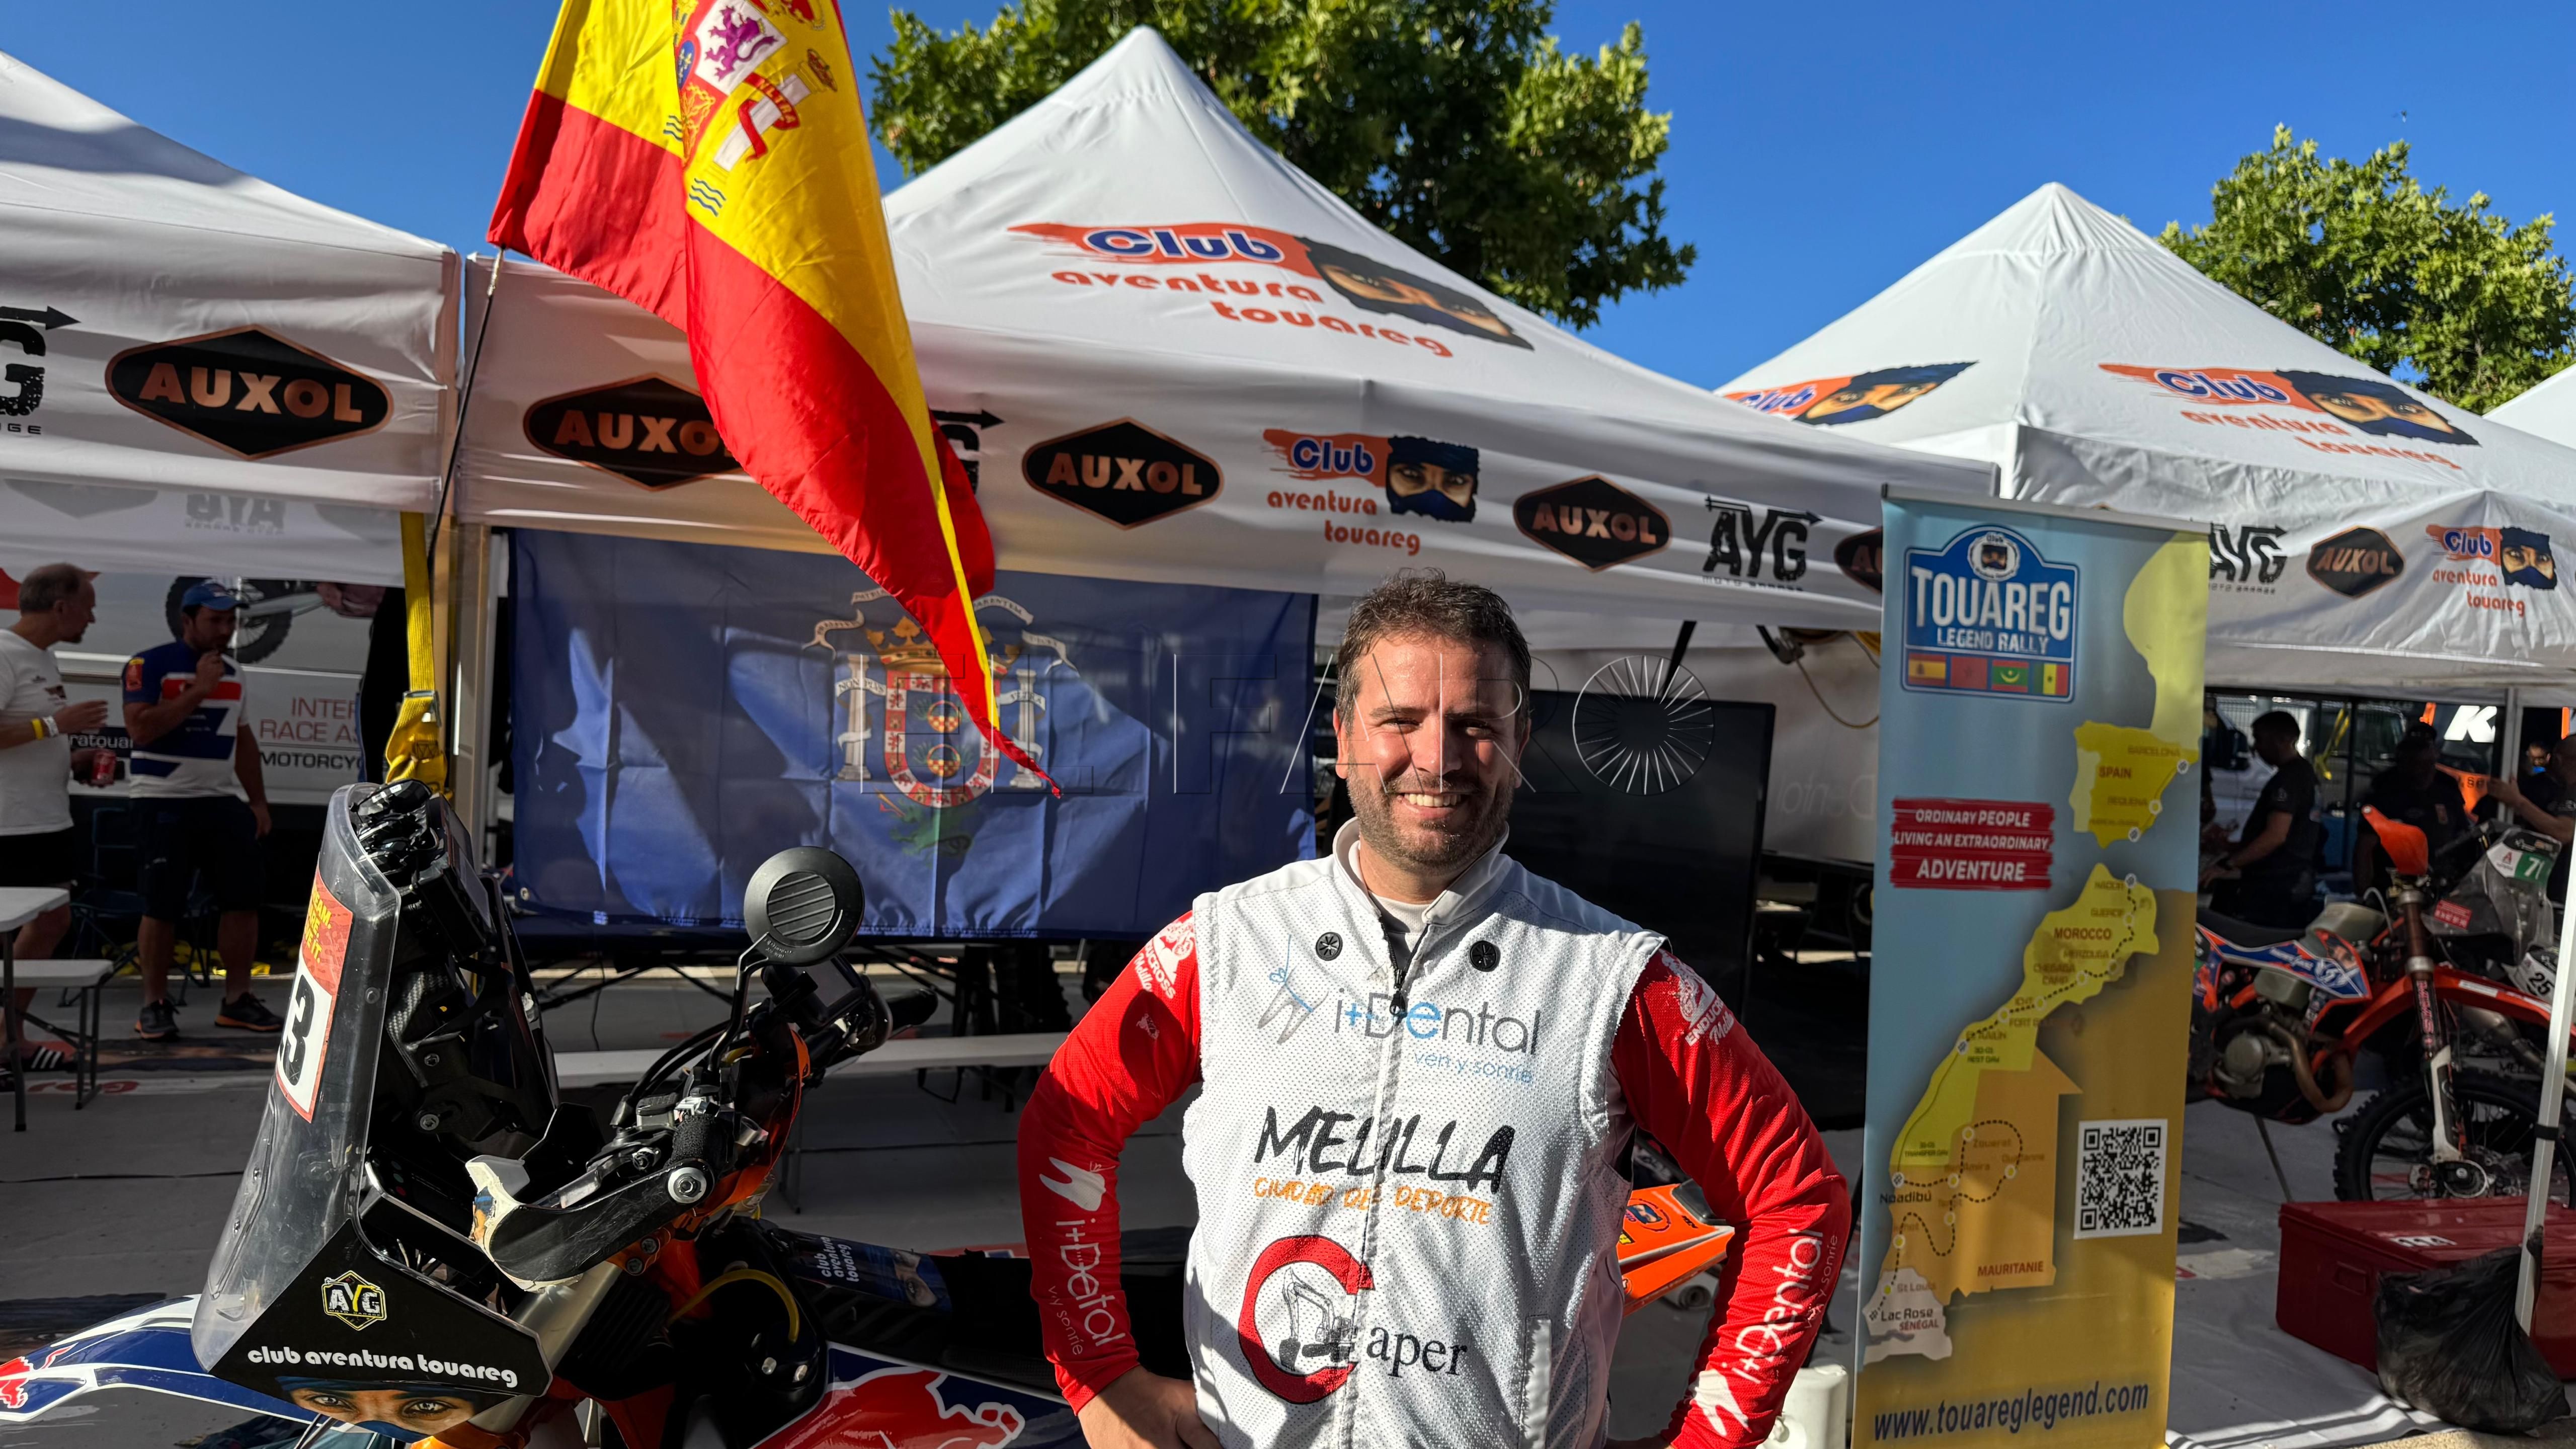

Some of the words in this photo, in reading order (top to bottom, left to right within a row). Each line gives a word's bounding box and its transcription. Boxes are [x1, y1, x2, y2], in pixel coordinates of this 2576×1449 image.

[1084, 229, 1283, 262] Club
[1052, 271, 1326, 303] aventura
[1209, 300, 1453, 357] touareg
[139, 362, 363, 423] AUXOL
[2154, 369, 2290, 403] Club
[552, 409, 734, 458] AUXO
[2181, 411, 2351, 436] aventura
[1291, 438, 1374, 475] Club
[2295, 436, 2462, 470] touareg
[1045, 453, 1202, 495] AUXOL
[1267, 490, 1377, 515] aventura
[1324, 521, 1421, 556] touareg
[1532, 503, 1656, 544] AUXOL
[1703, 502, 1808, 582] AYG
[2444, 530, 2492, 558] Club
[2315, 547, 2395, 575] AUXOL
[2433, 569, 2498, 587] aventura
[1913, 567, 2070, 640] TOUAREG
[2466, 591, 2525, 617] touareg
[1937, 627, 1994, 650] LEGEND
[1998, 634, 2049, 654] RALLY
[260, 719, 328, 742] RACE
[335, 724, 358, 744] A
[2099, 767, 2131, 778] SPAIN
[1916, 809, 1977, 825] ORDINARY
[1978, 811, 2030, 827] PEOPLE
[1895, 832, 1933, 847] LIVING
[1936, 833, 1952, 847] AN
[1954, 833, 2050, 851] EXTRAORDINARY
[1916, 859, 2026, 881] ADVENTURE
[311, 886, 332, 929] REAM.
[2054, 927, 2111, 940] MOROCCO
[1415, 1052, 1450, 1067] ven
[1456, 1058, 1468, 1072] y
[1254, 1106, 1515, 1193] MELILLA
[1254, 1176, 1334, 1206] CIUDAD
[1344, 1187, 1381, 1210] DEL
[1395, 1185, 1492, 1225] DEPORTE
[814, 1253, 832, 1277] club
[821, 1237, 844, 1277] aventura
[837, 1244, 859, 1282] touareg
[1977, 1261, 2043, 1276] MAURITANIE
[329, 1282, 381, 1314] AYG
[1881, 1310, 1901, 1321] Lac
[1903, 1308, 1934, 1319] Rose
[1899, 1319, 1939, 1331] SÉNÉGAL
[247, 1345, 300, 1365] club
[305, 1349, 415, 1371] aventura
[419, 1357, 517, 1388] touareg
[1874, 1381, 2149, 1441] www.touareglegend.com
